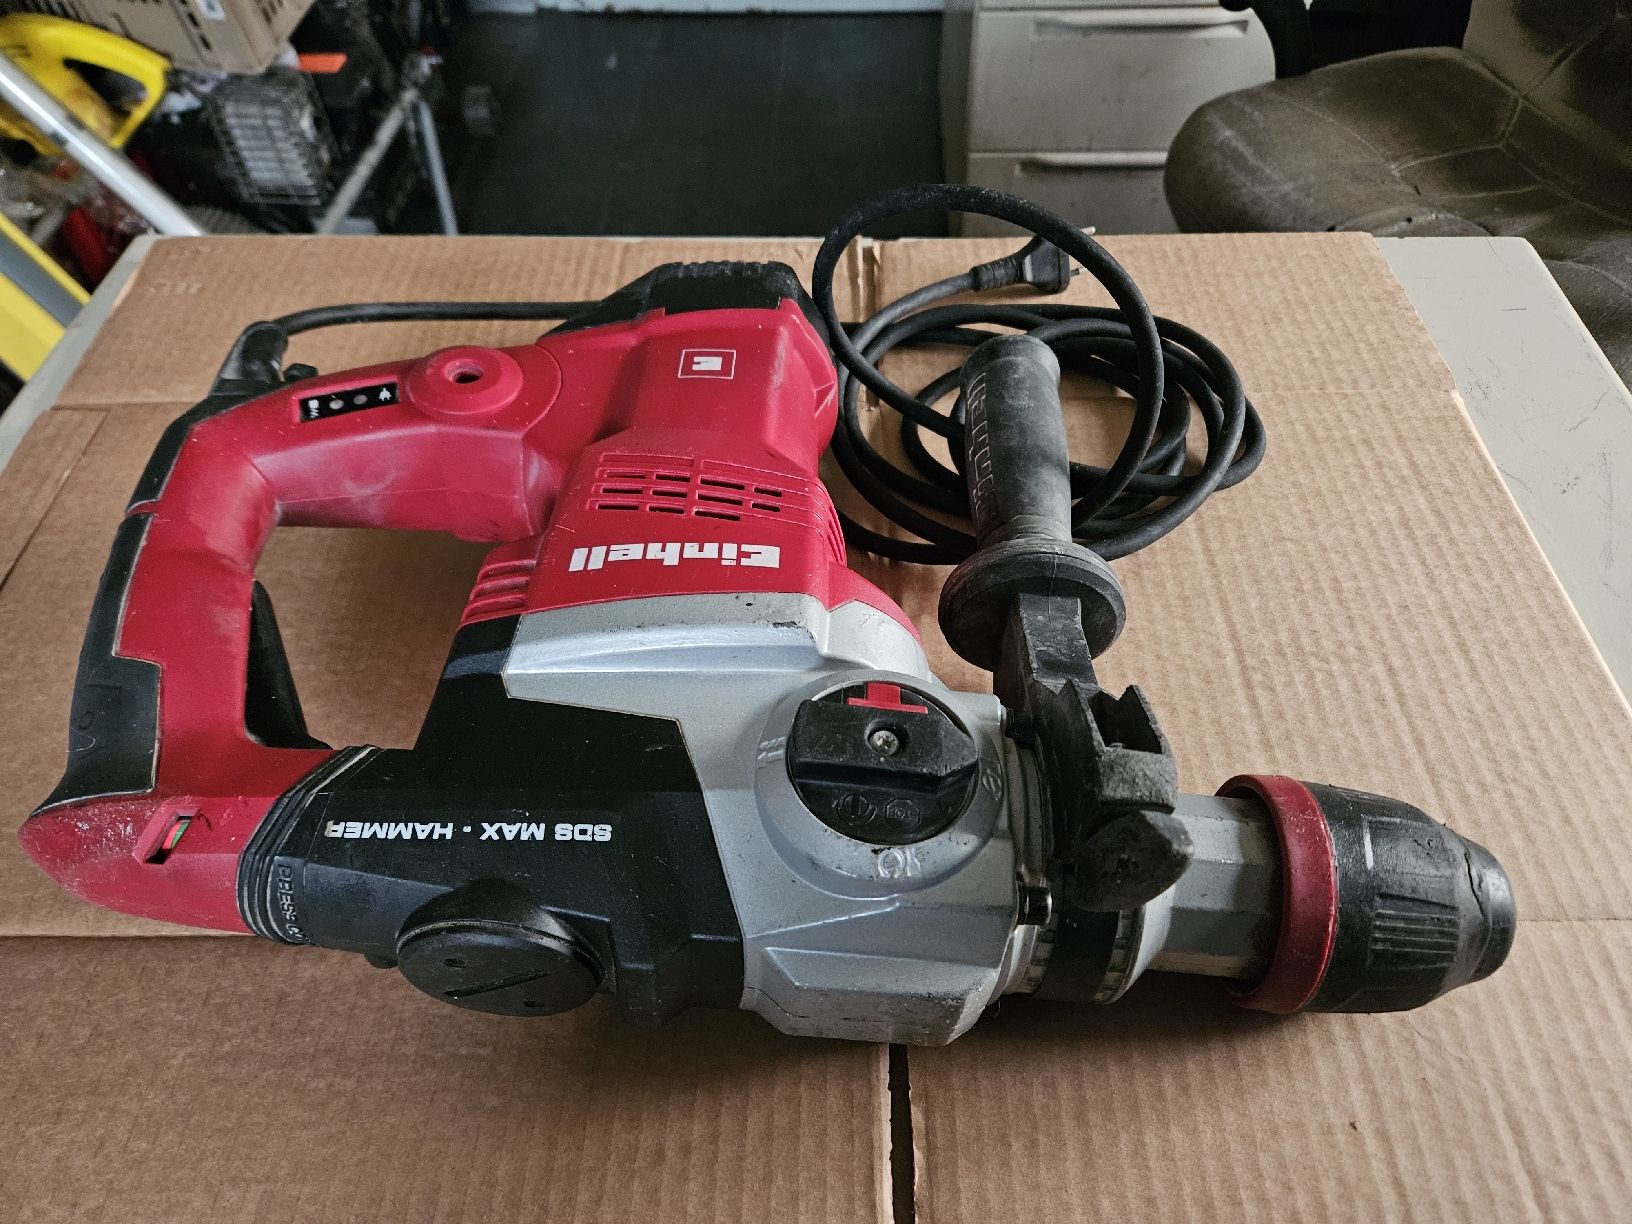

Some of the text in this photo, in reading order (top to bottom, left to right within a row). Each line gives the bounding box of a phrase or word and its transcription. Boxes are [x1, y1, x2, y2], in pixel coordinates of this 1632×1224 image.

[568, 543, 780, 572] Einhell
[324, 819, 453, 841] HAMMER
[478, 822, 546, 841] MAX
[554, 822, 613, 842] SDS
